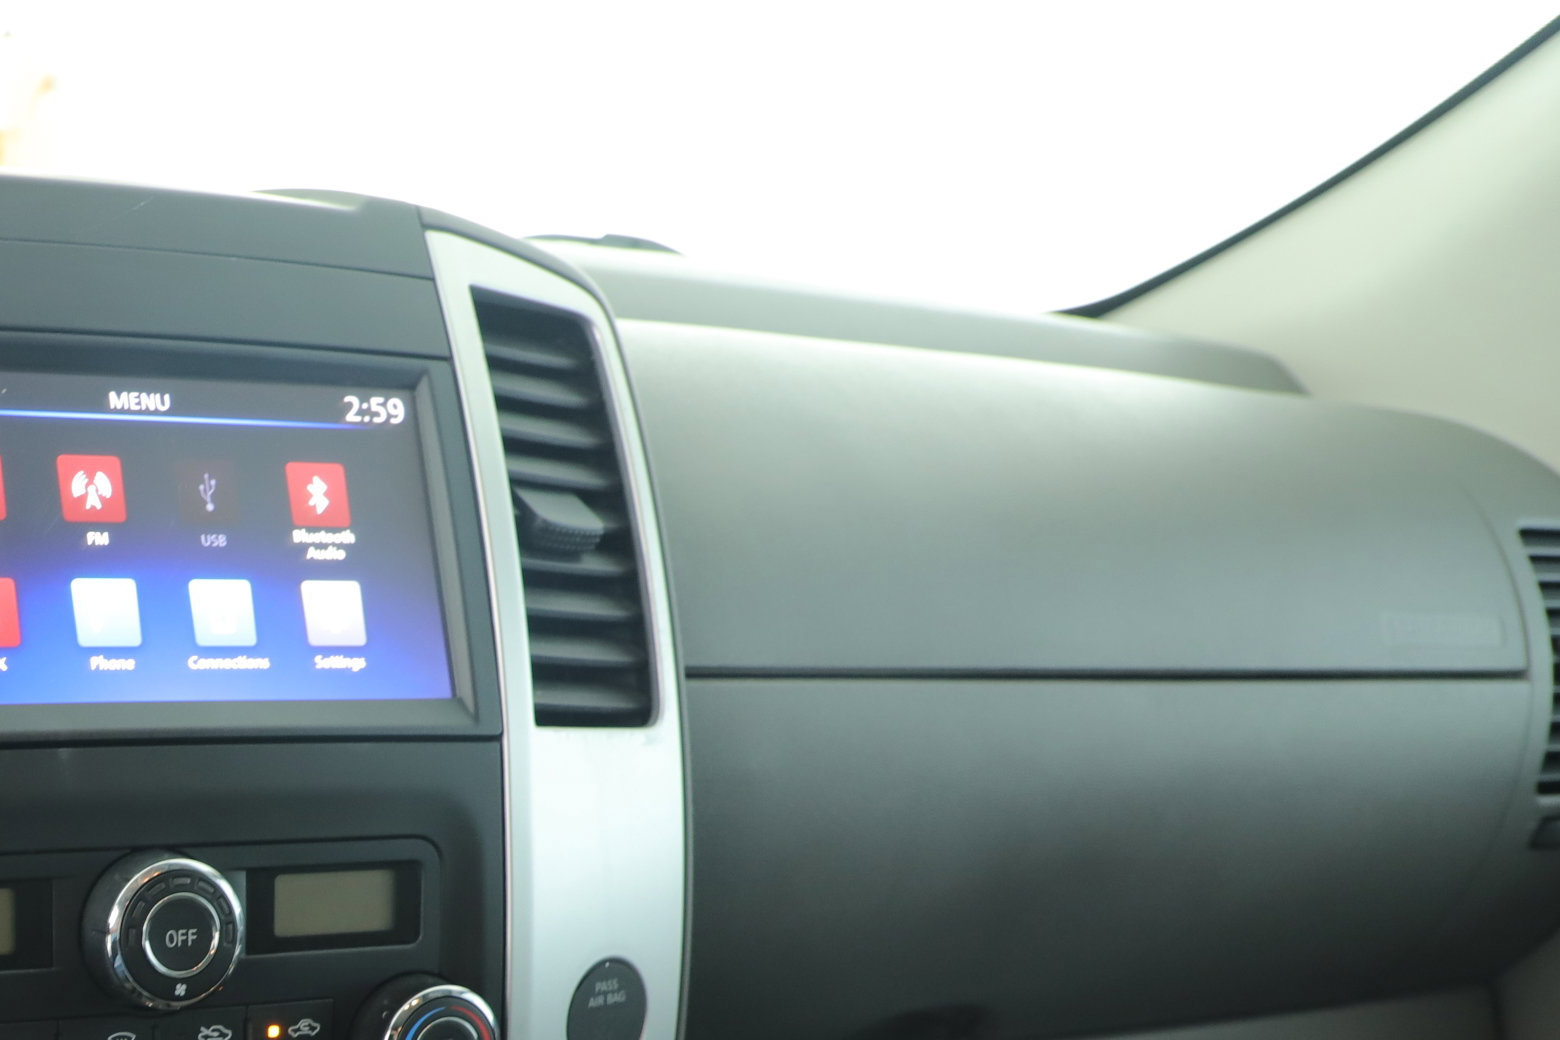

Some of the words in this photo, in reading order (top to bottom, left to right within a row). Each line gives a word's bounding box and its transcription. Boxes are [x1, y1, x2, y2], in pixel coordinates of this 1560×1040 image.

[108, 391, 171, 412] MENU
[344, 396, 405, 424] 2:59
[87, 531, 109, 546] FM
[201, 534, 227, 547] USB
[90, 656, 136, 671] Phone
[188, 655, 270, 671] Connections
[314, 655, 367, 672] Settings
[165, 928, 198, 949] OFF
